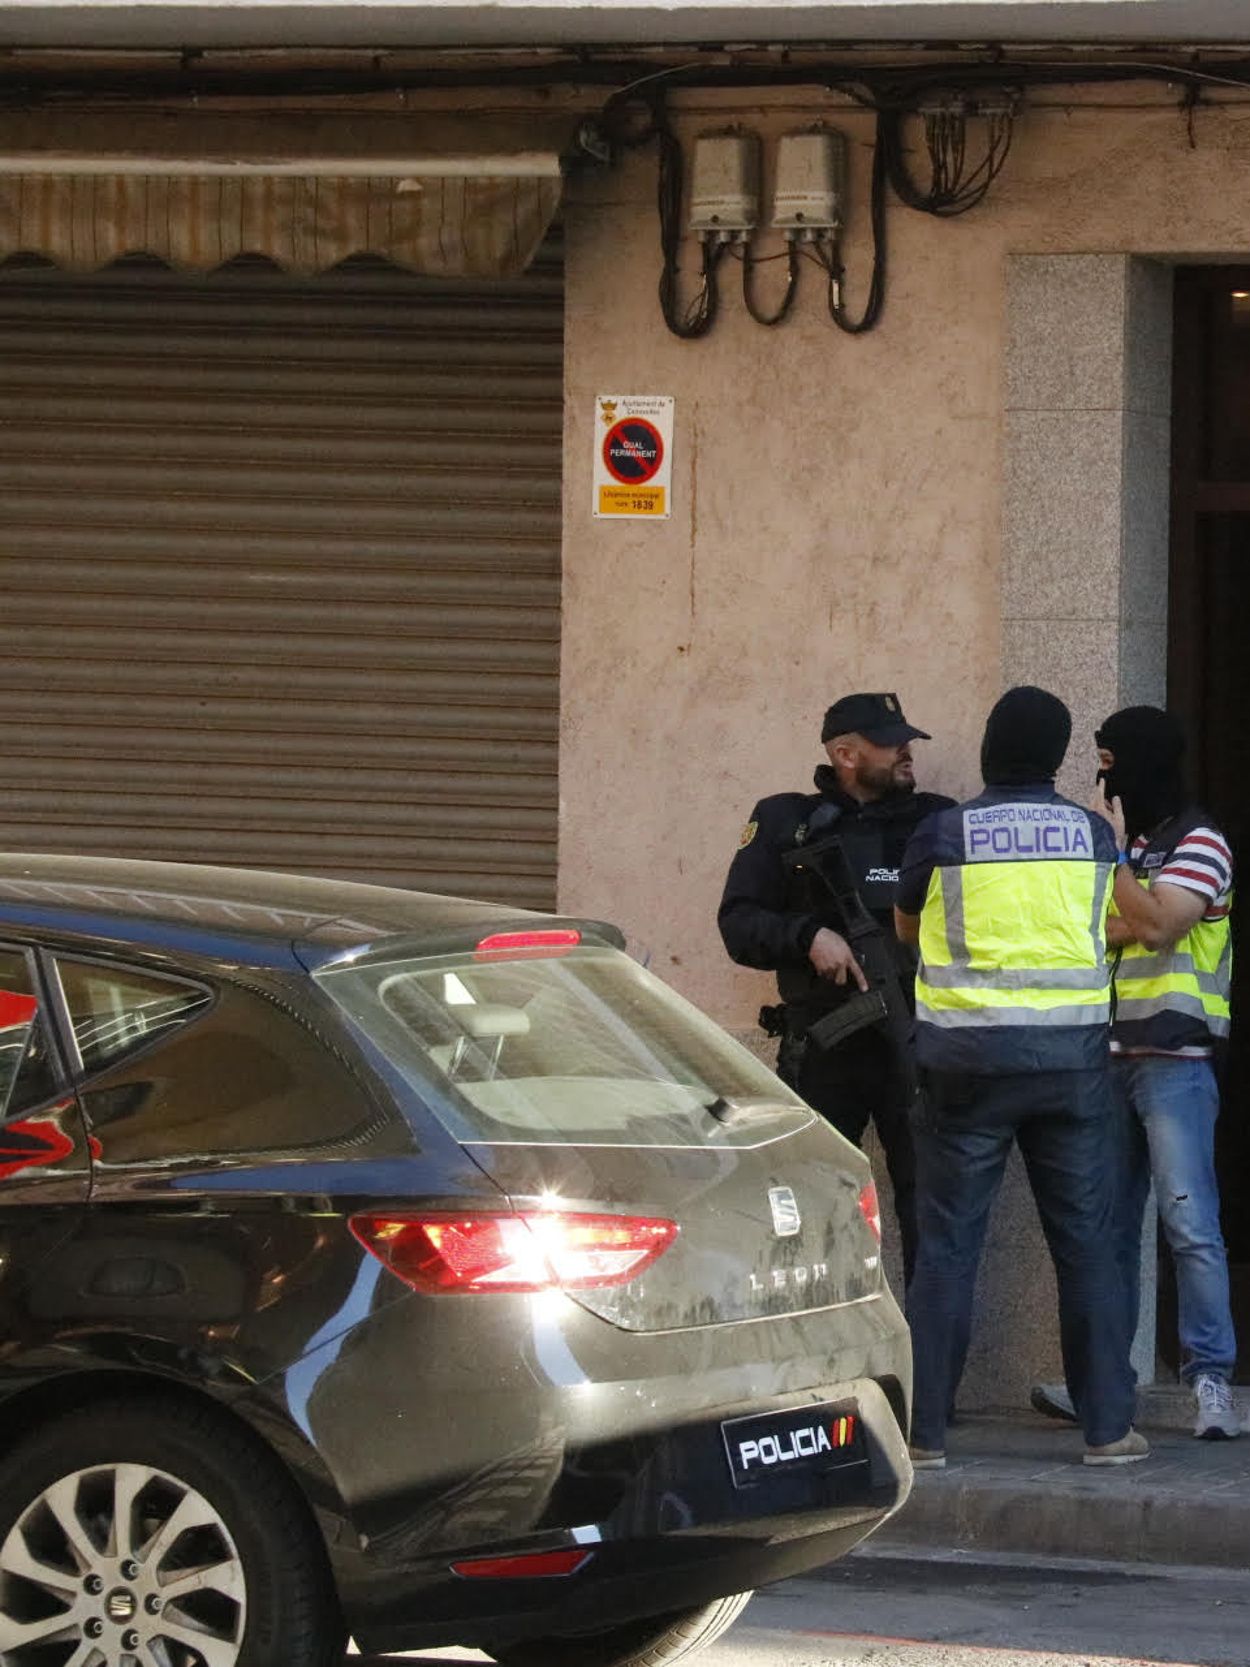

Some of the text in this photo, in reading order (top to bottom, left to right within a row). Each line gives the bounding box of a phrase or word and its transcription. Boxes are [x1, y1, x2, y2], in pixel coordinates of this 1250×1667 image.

[623, 441, 644, 449] GUAL
[609, 449, 657, 458] PERMANENT
[968, 808, 1086, 824] CUERPO NACIONAL DE
[969, 826, 1089, 855] POLICIA
[739, 1425, 832, 1470] POLICIA
